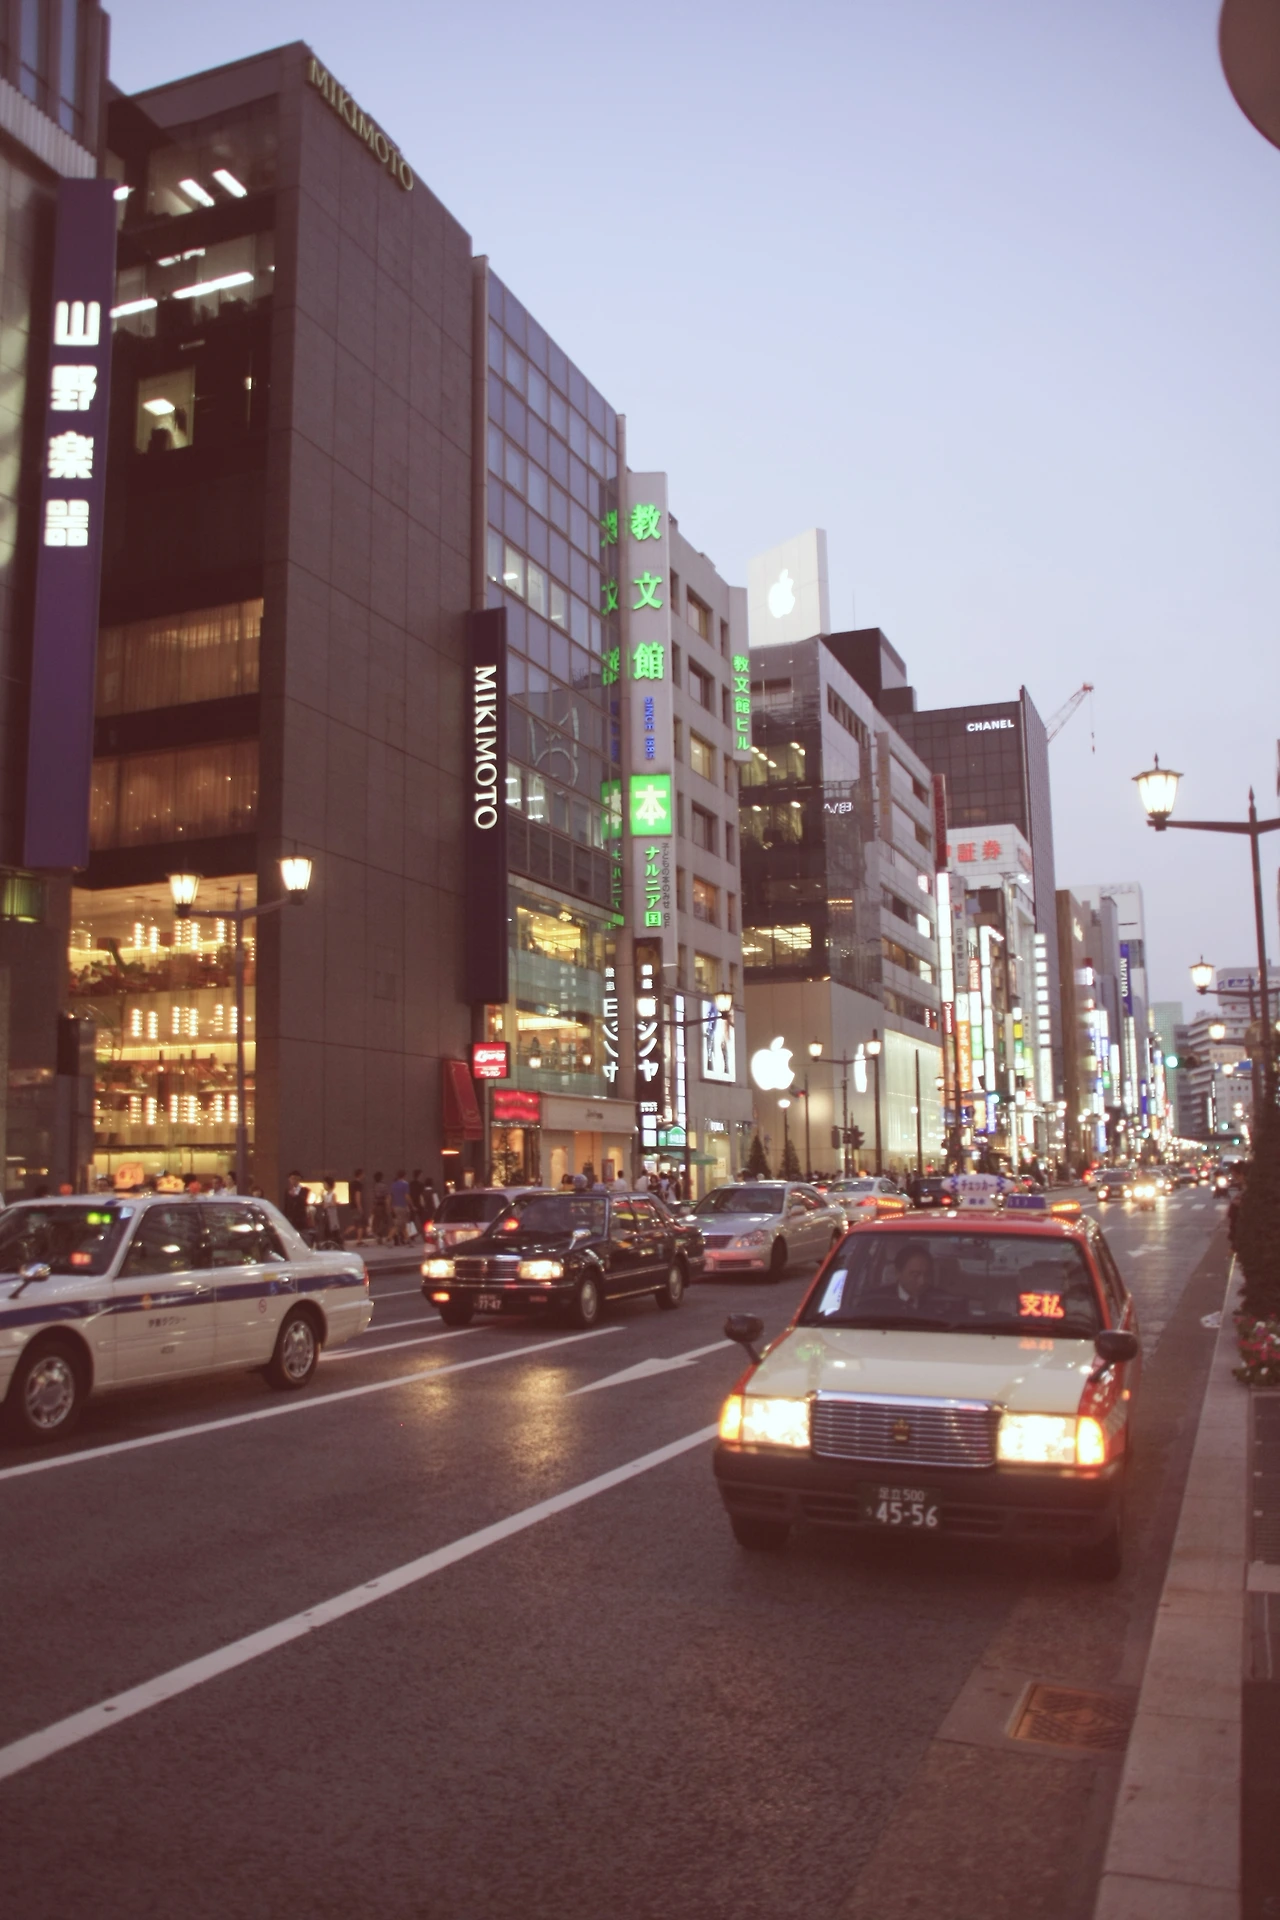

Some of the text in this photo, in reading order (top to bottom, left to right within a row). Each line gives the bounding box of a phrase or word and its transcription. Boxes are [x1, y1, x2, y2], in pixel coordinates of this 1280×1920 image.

[307, 57, 415, 191] MIKIMOTO
[44, 300, 101, 547] 山野楽器
[630, 503, 665, 681] 教文館
[644, 696, 655, 731] SINCE
[733, 655, 751, 752] 教文館ビル
[965, 718, 1015, 732] CHANEL
[474, 665, 499, 830] MIKIMOTO
[635, 784, 667, 826] 本
[644, 846, 662, 927] ナルニア国
[1120, 958, 1129, 997] MIZUHO
[637, 997, 659, 1083] シノヤ
[961, 1179, 995, 1191] チェッカー
[1019, 1293, 1064, 1319] 支払
[876, 1501, 938, 1527] 45-56
[878, 1487, 925, 1502] 足立 500
